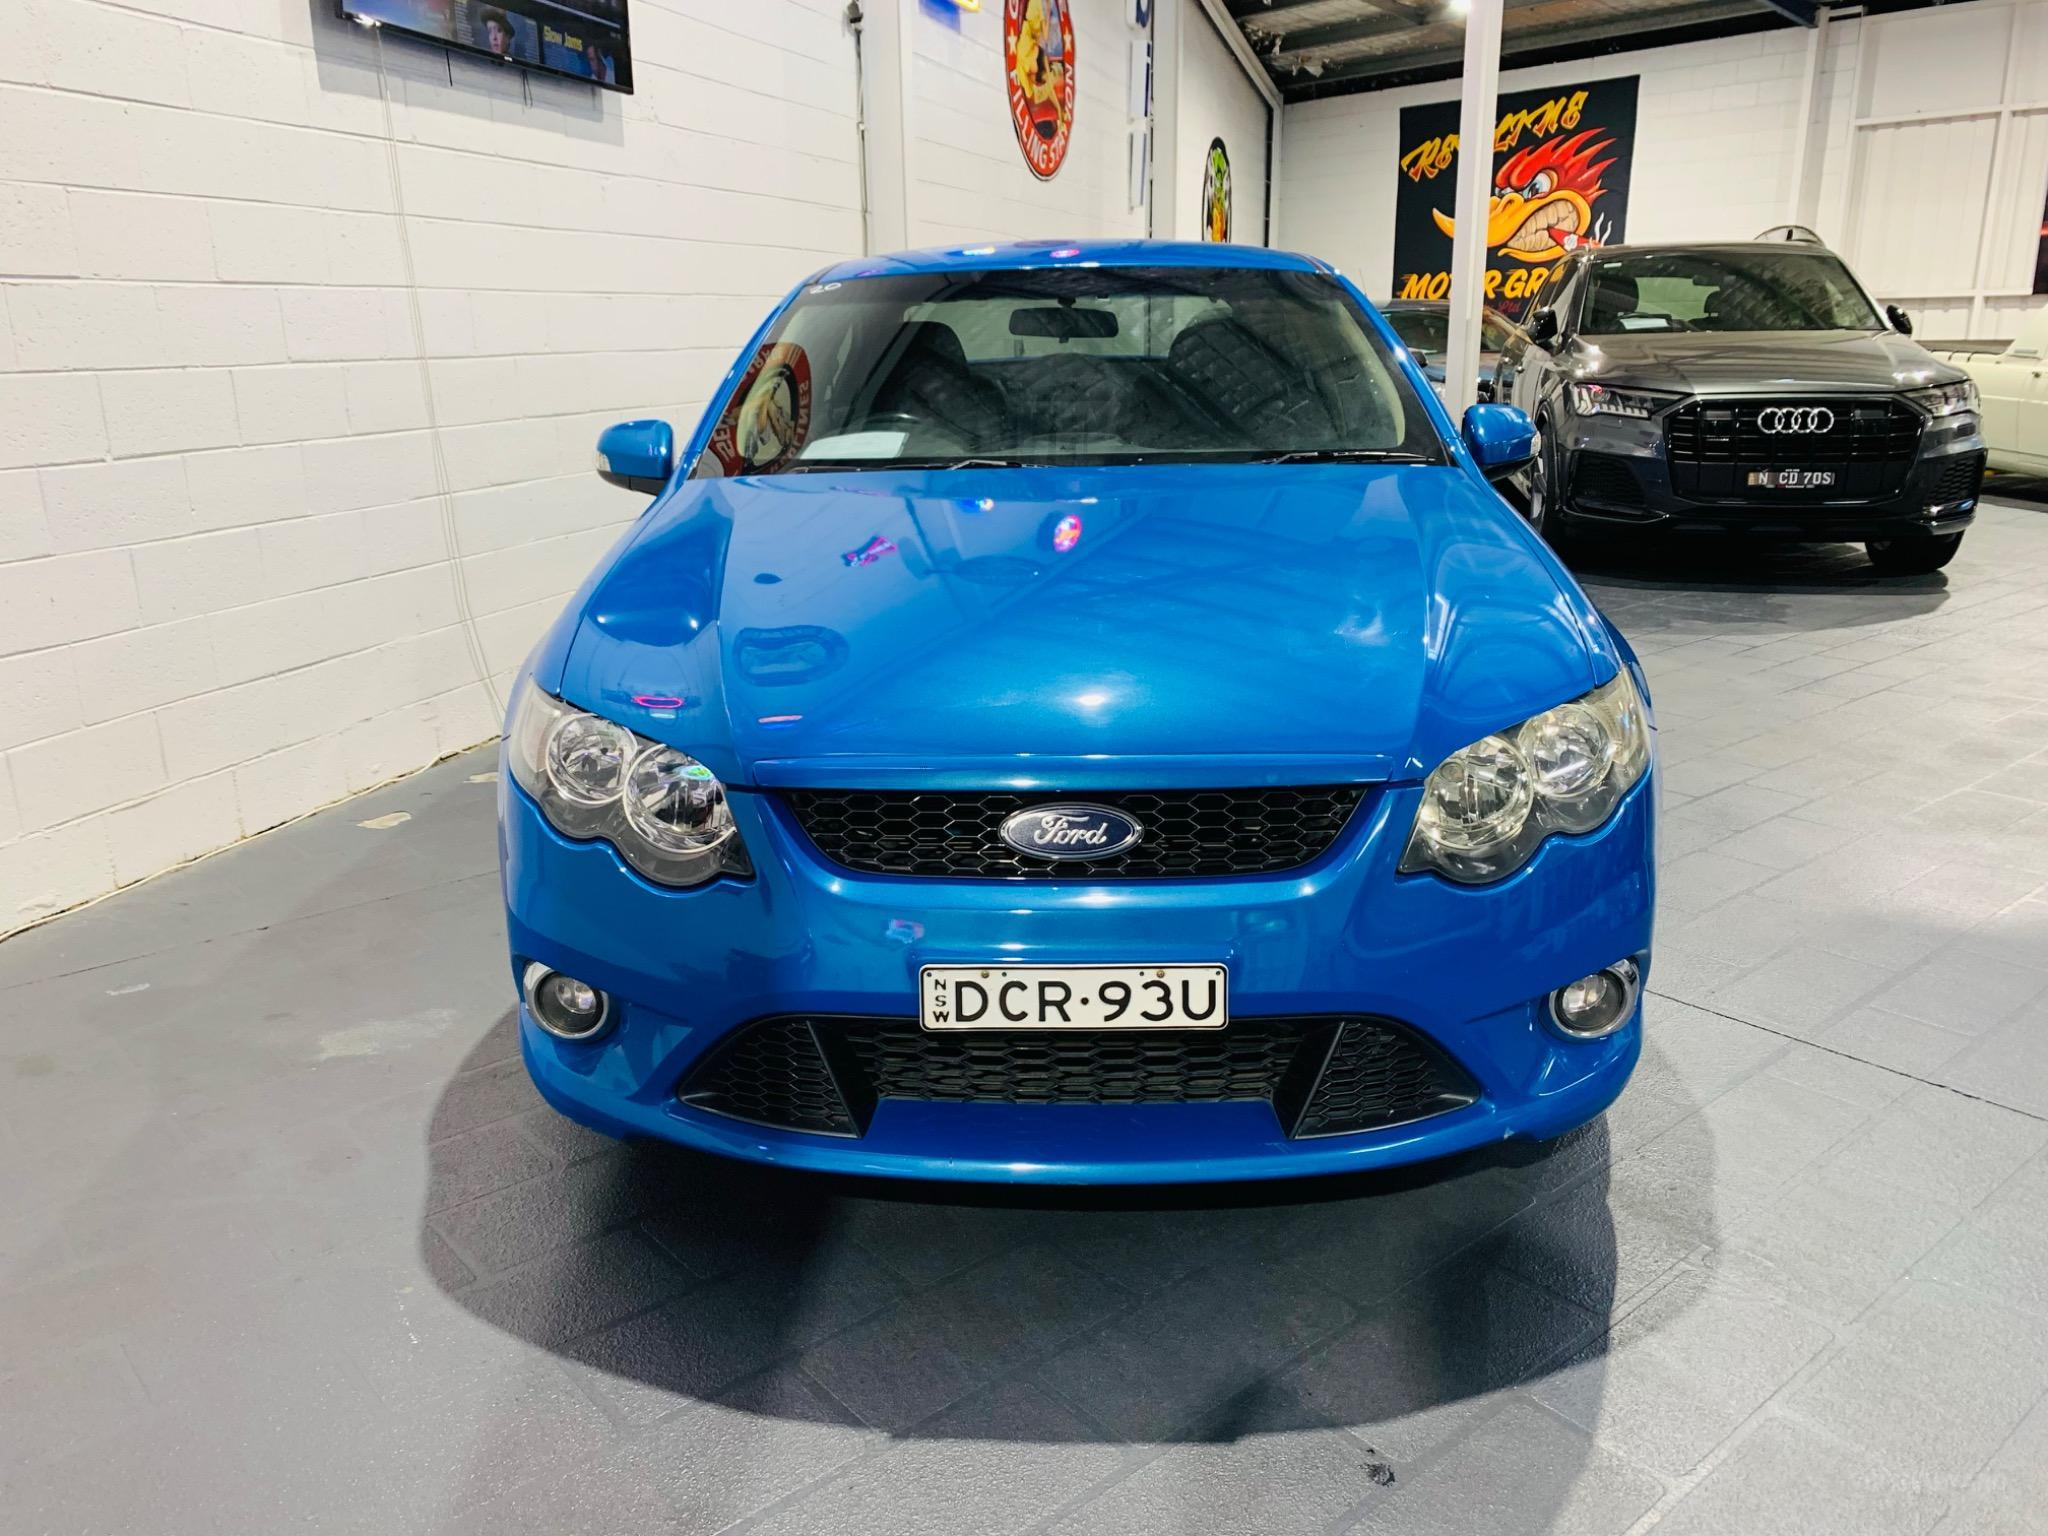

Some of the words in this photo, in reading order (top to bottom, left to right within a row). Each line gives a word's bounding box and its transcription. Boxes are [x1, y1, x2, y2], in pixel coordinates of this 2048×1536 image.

[1009, 69, 1048, 169] FILLING
[1401, 91, 1589, 182] RELINE
[1400, 270, 1502, 300] MOR
[1779, 471, 1799, 485] CD
[1033, 815, 1109, 845] Ford
[933, 978, 950, 1023] NSW
